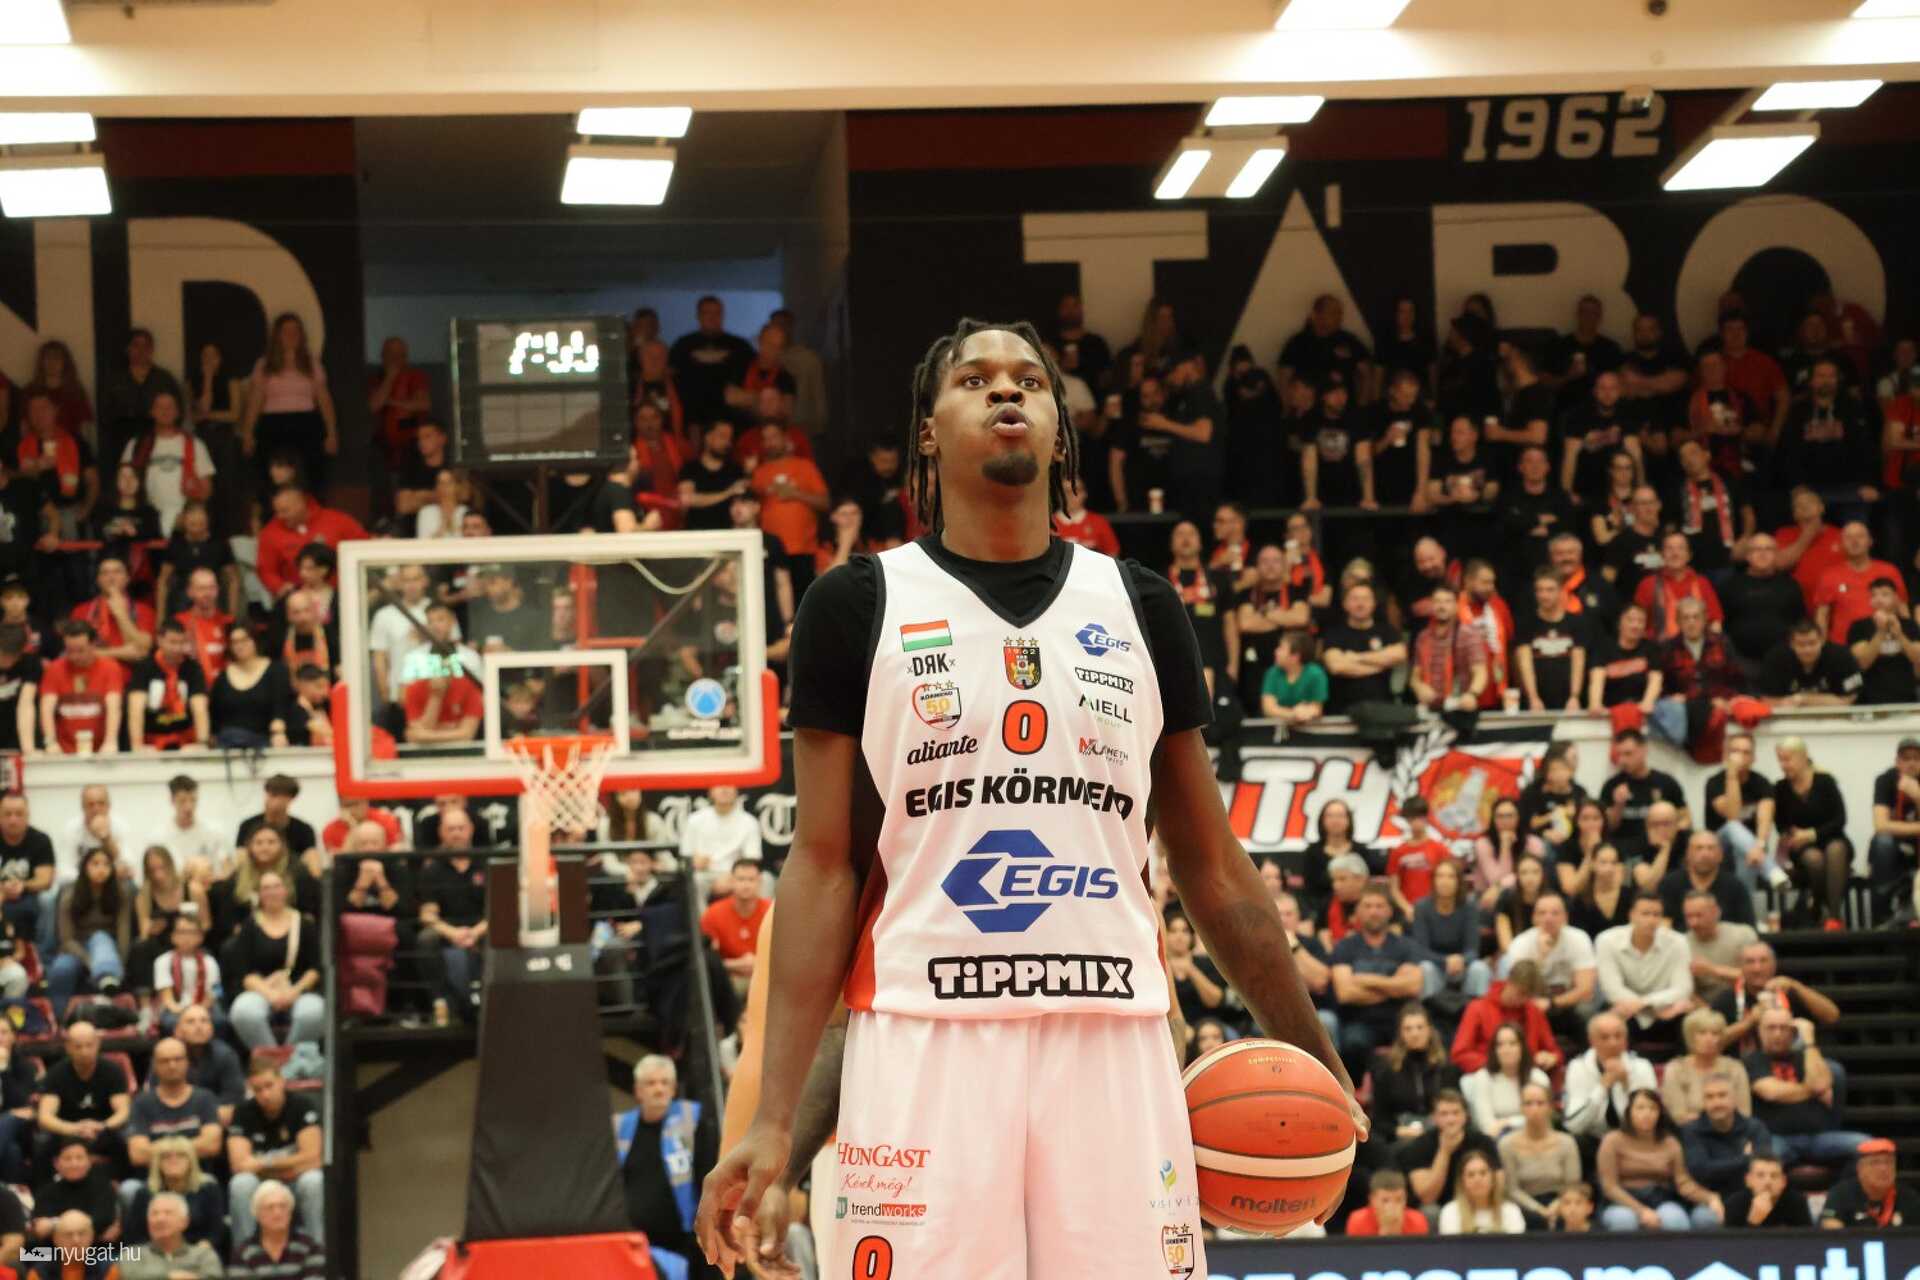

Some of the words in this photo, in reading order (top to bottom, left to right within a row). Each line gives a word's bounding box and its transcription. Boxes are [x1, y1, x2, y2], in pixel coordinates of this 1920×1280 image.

[1463, 95, 1665, 162] 1962
[1094, 634, 1132, 652] EGIS
[1002, 699, 1048, 755] 0
[907, 735, 979, 765] aliante
[905, 778, 975, 818] EGIS
[1000, 865, 1119, 900] EGIS
[851, 1203, 927, 1217] trendworks
[1231, 1195, 1317, 1215] molten
